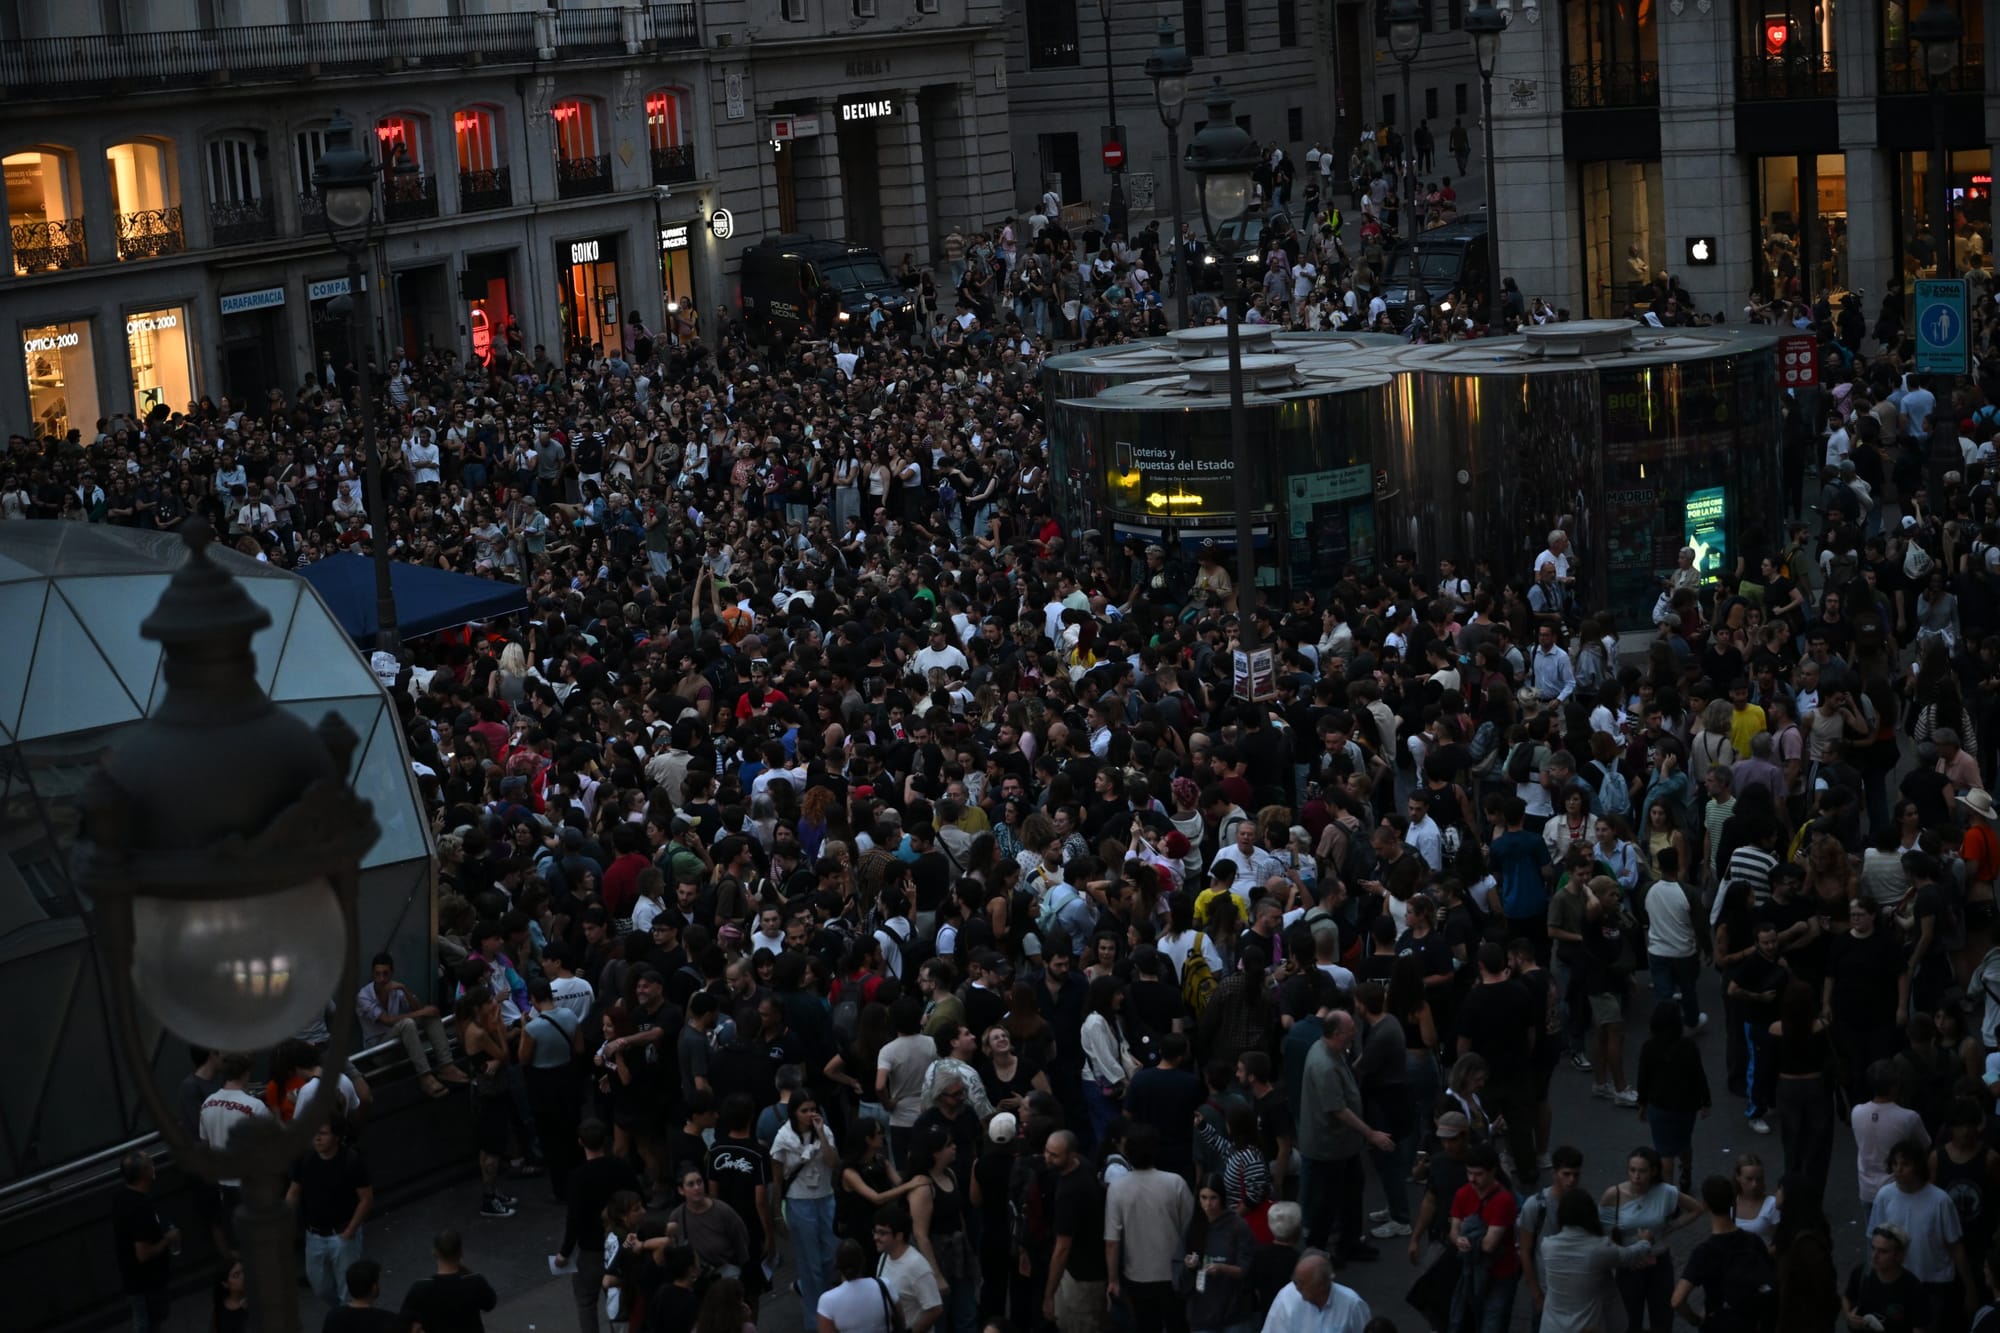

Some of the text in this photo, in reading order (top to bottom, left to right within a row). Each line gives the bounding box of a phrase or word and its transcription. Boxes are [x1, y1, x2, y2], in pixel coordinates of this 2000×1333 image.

[842, 100, 892, 120] DECIMAS
[571, 240, 599, 264] GOIKO
[222, 291, 283, 311] PARAFARMACIA
[126, 315, 177, 334] OPTICA 2000
[24, 333, 79, 353] OPTICA 2000
[1132, 447, 1176, 459] Loterías y
[1134, 459, 1235, 471] Apuestas del Estado
[1608, 490, 1653, 502] MADRID
[1687, 505, 1722, 518] POR LA PAZ
